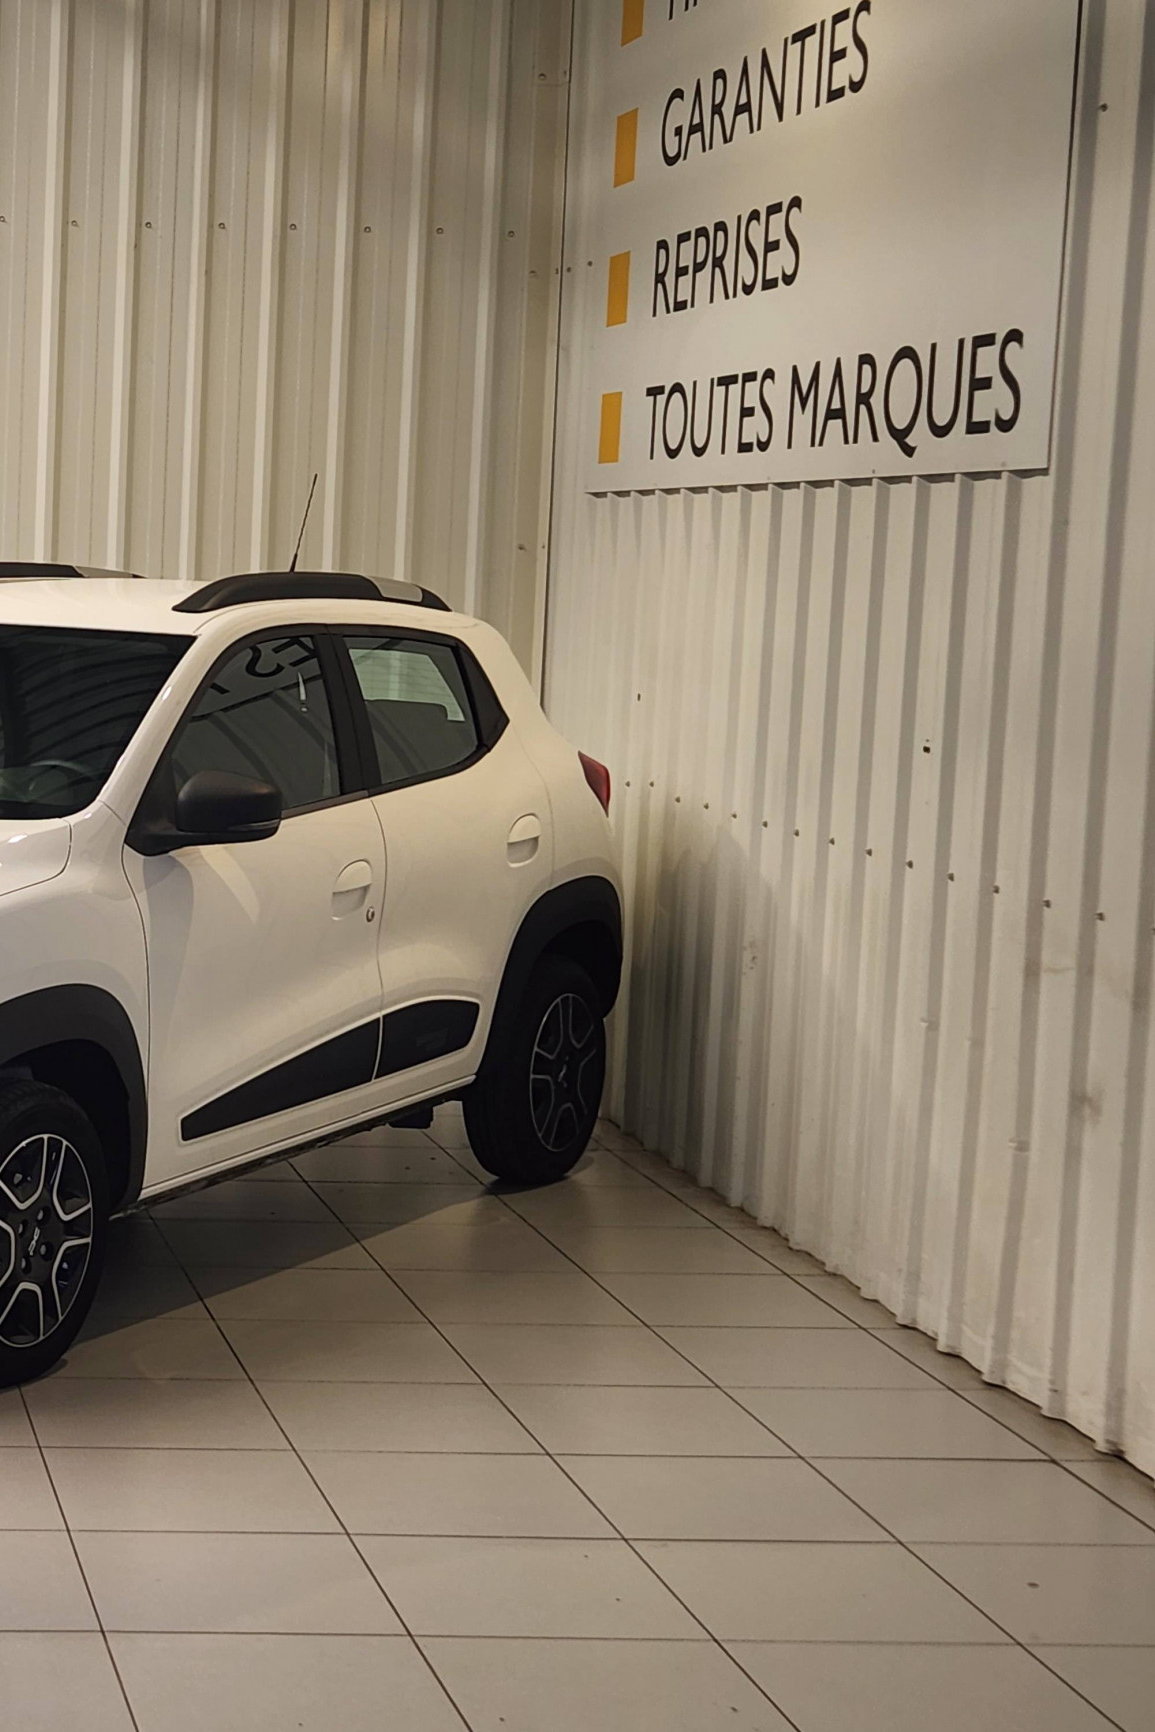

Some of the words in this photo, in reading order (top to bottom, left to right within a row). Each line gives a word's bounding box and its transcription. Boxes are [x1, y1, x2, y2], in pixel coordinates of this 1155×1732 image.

[661, 0, 872, 167] GARANTIES
[652, 195, 803, 318] REPRISES
[645, 367, 776, 461] TOUTES
[786, 328, 1025, 459] MARQUES
